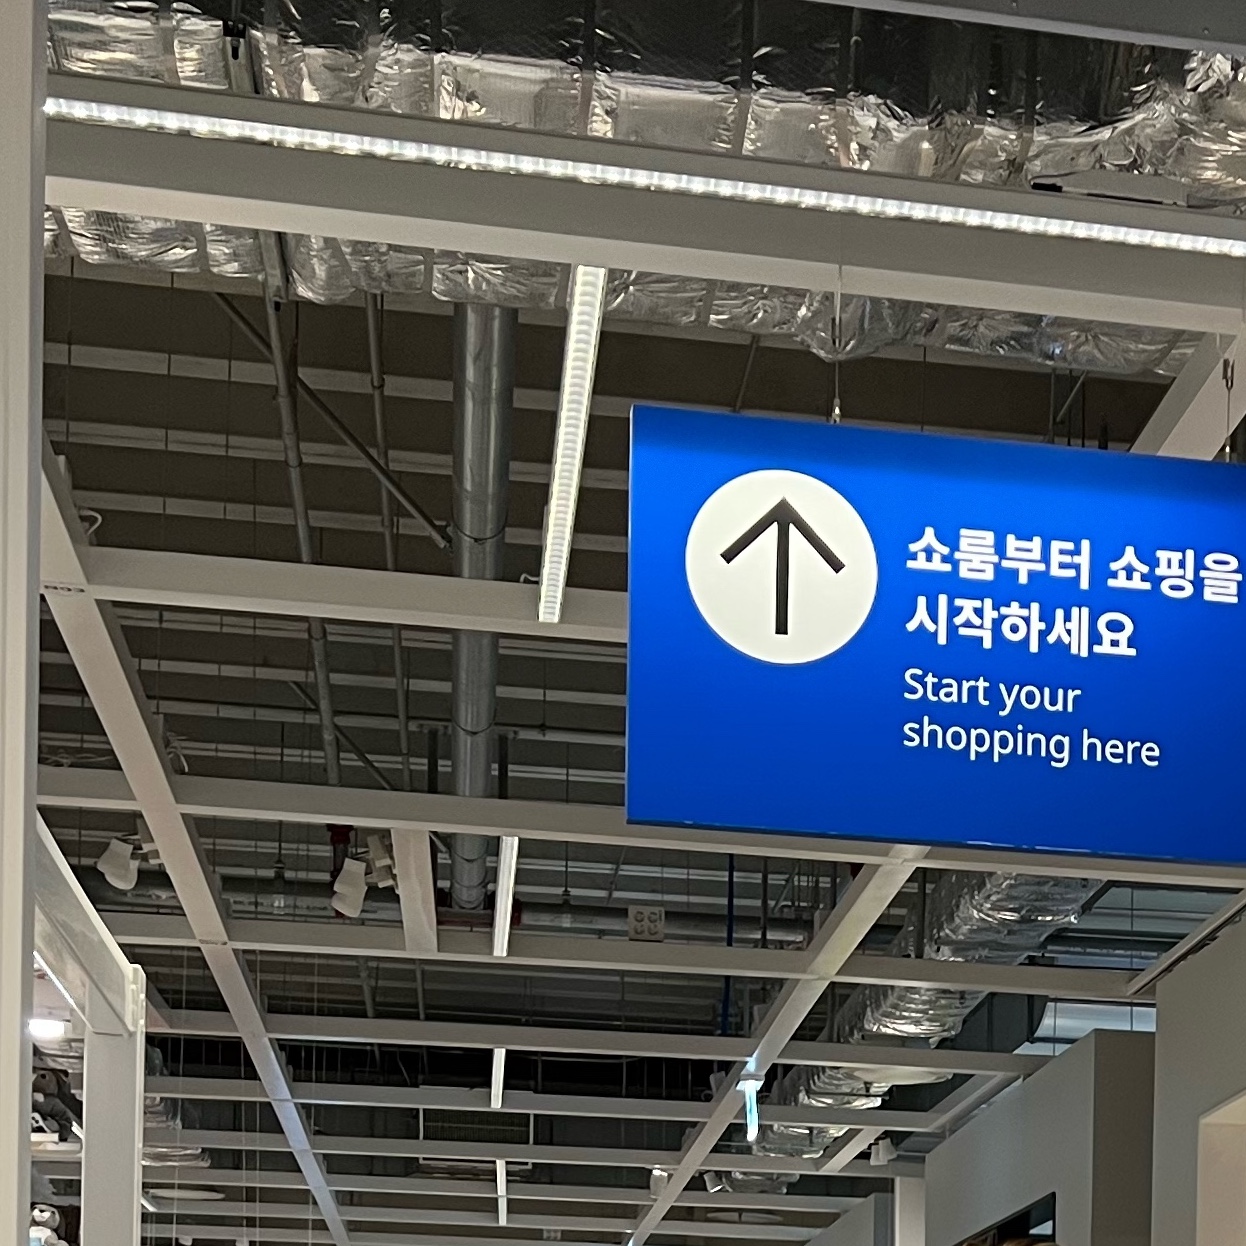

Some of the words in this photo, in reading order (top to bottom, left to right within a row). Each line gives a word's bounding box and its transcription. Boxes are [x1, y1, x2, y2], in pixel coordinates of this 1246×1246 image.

[906, 526, 1091, 591] 쇼룸부터
[1106, 545, 1243, 604] 쇼핑을
[905, 593, 1137, 658] 시작하세요
[903, 668, 990, 706] Start
[998, 682, 1082, 717] your
[903, 715, 1070, 768] shopping
[1082, 728, 1160, 767] here
